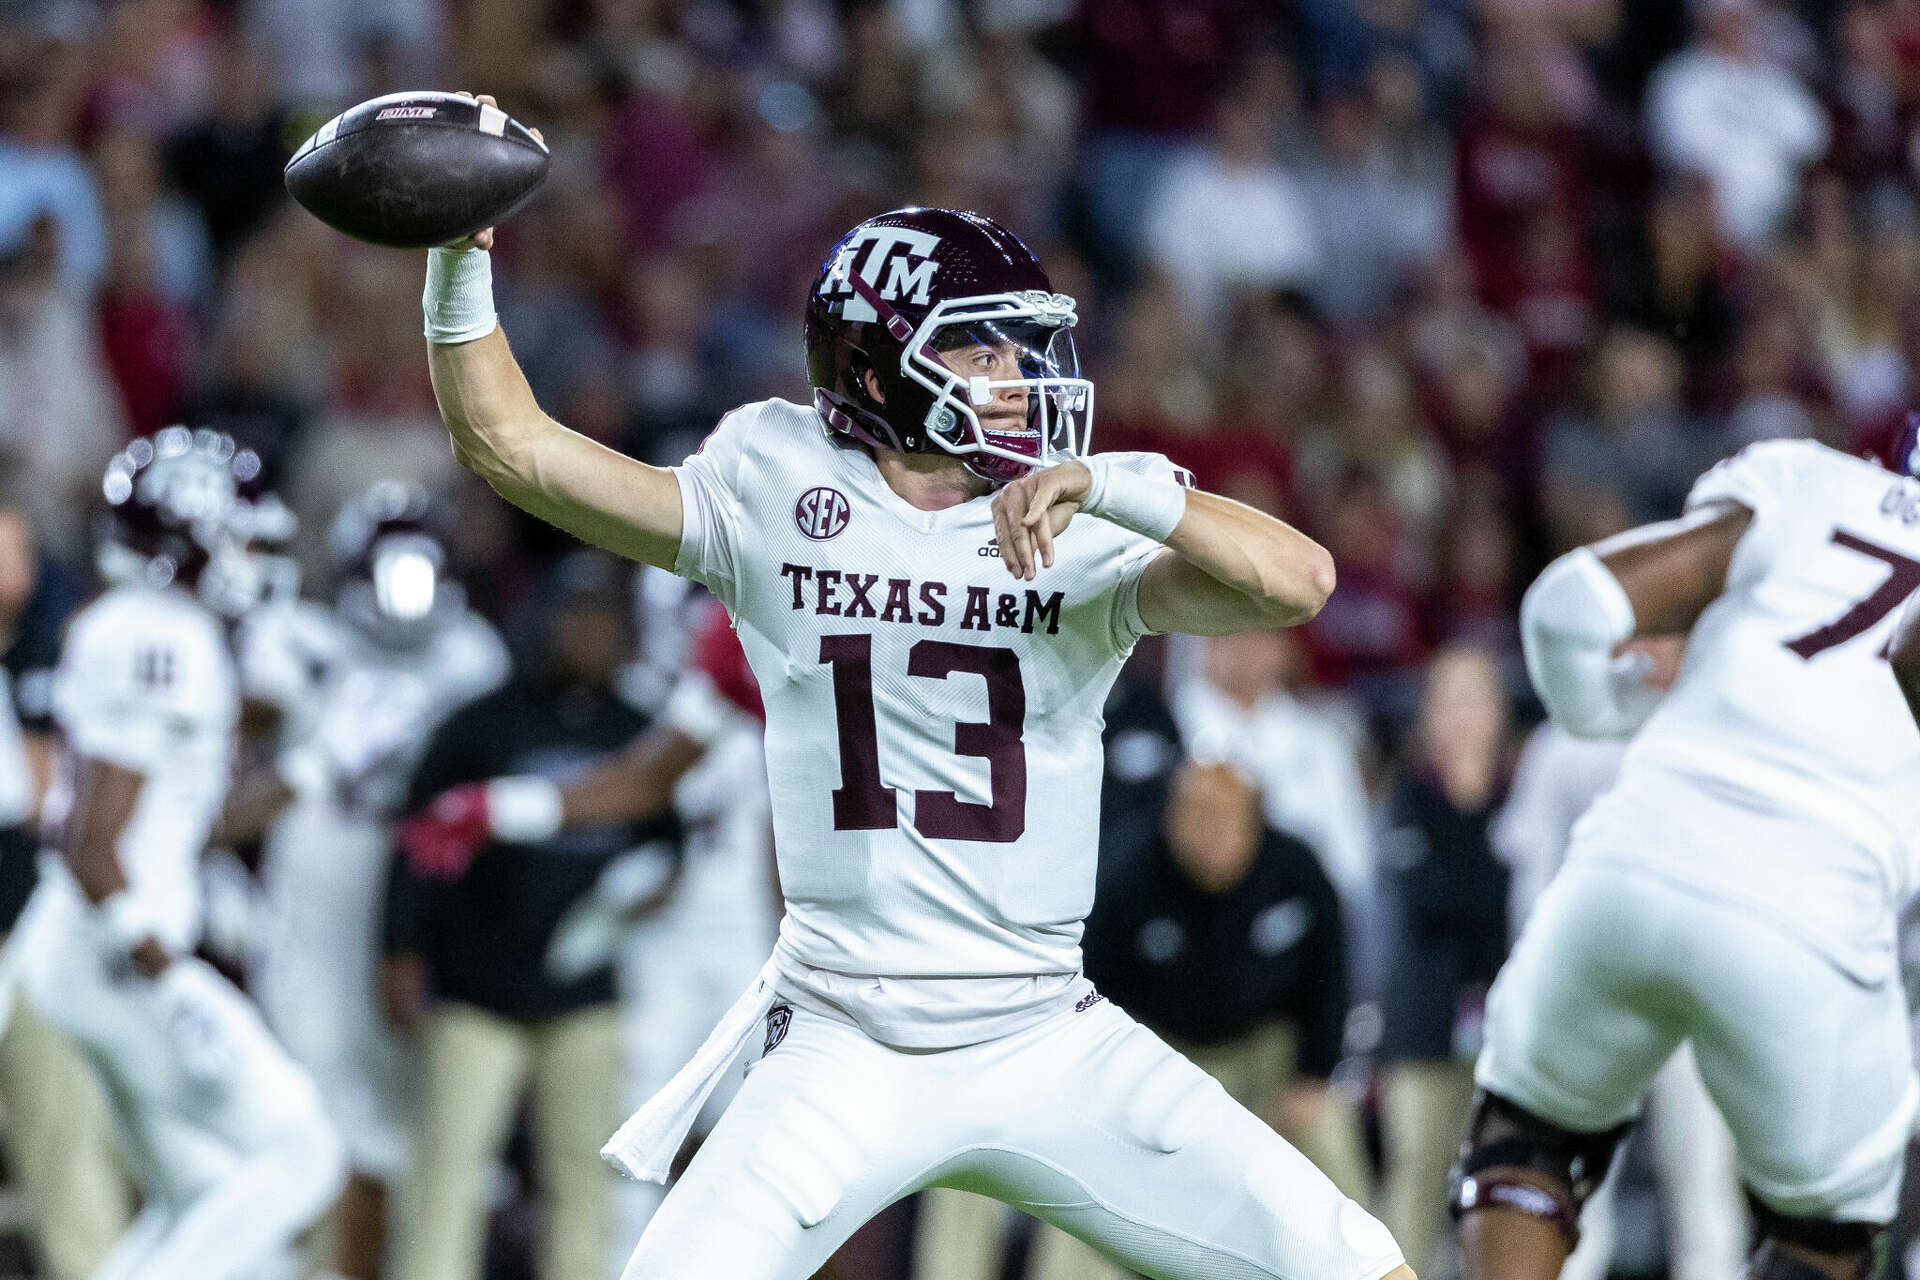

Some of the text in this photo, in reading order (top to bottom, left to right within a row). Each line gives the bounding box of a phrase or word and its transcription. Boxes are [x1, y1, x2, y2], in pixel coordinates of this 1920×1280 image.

[798, 488, 848, 537] SEC
[781, 562, 1065, 635] TEXAS A&M
[1782, 528, 1920, 660] 7
[819, 634, 1027, 843] 13
